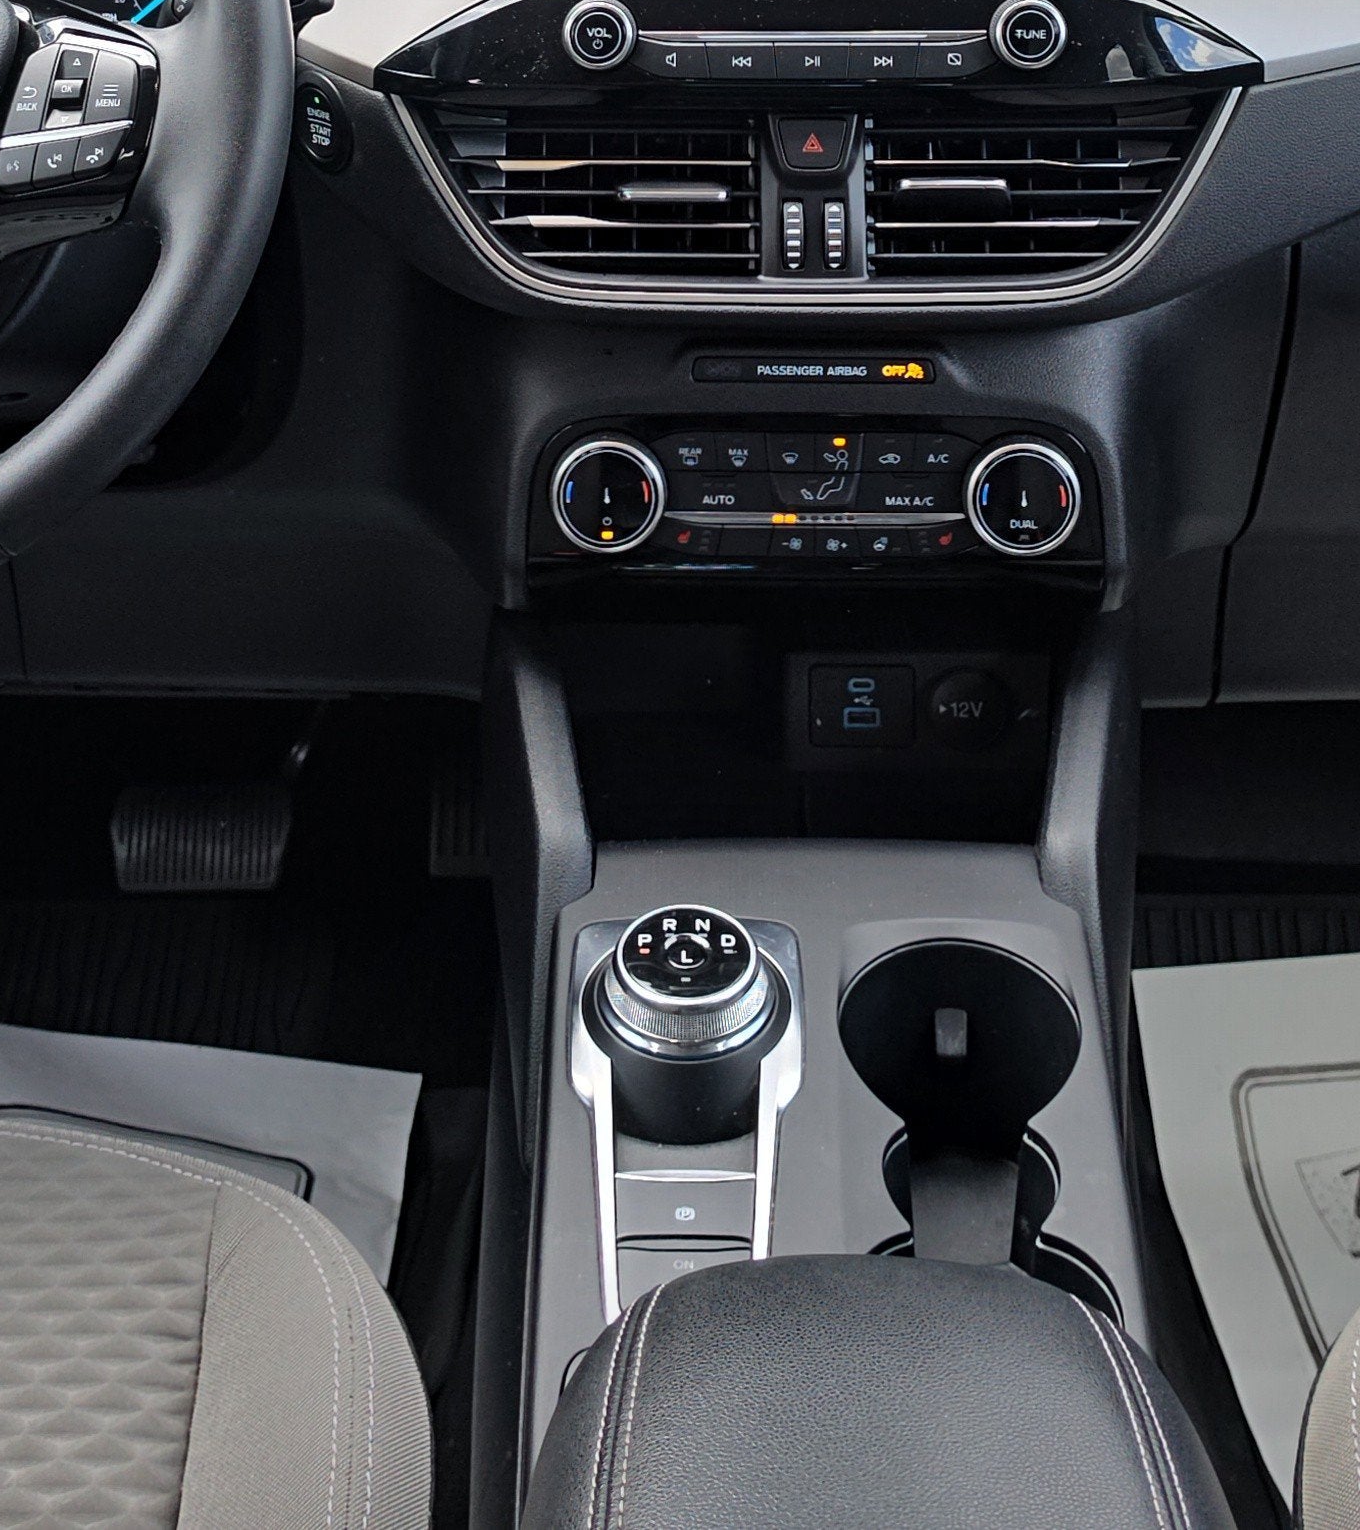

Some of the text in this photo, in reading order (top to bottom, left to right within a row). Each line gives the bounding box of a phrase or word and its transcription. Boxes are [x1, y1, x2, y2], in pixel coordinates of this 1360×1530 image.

[586, 27, 610, 39] VOL
[1015, 28, 1047, 41] TUNE
[61, 84, 73, 93] OK
[16, 102, 38, 112] BACK
[95, 98, 121, 107] MENU
[310, 123, 331, 137] START
[312, 133, 331, 146] STOP
[756, 365, 905, 377] PASSENGER AIRBAG OFF
[678, 447, 702, 455] REAR
[728, 448, 749, 456] MAX
[927, 453, 950, 465] A/C
[702, 495, 735, 506] AUTO
[885, 495, 935, 507] MAX A/C
[1010, 518, 1038, 530] DUAL
[949, 701, 983, 718] 12V
[637, 918, 736, 948] P R N D
[680, 950, 694, 964] L
